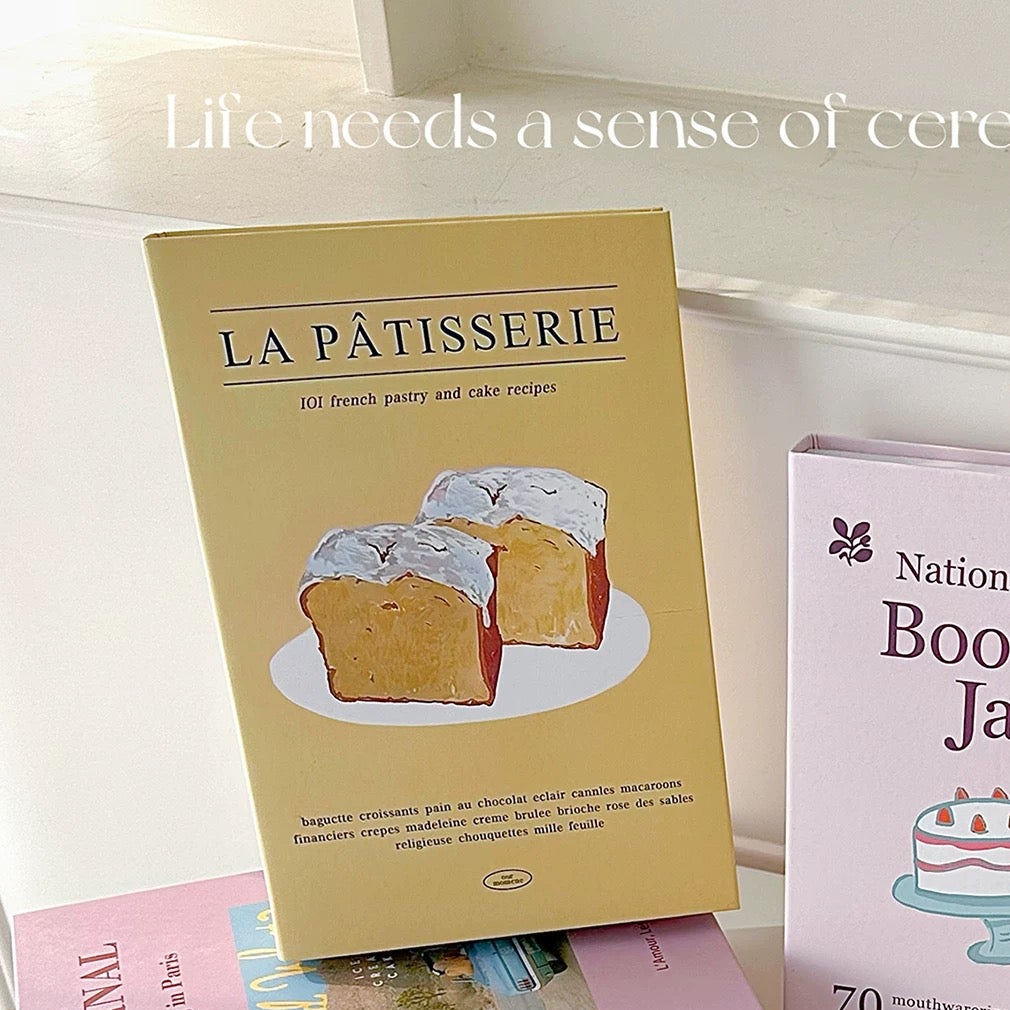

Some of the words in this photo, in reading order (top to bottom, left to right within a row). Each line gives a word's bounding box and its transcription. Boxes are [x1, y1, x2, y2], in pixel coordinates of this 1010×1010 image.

[218, 325, 295, 369] LA
[310, 305, 621, 363] PÂTISSERIE
[330, 393, 377, 408] french
[384, 391, 428, 407] pastry
[435, 387, 461, 401] and
[468, 384, 500, 399] cake
[507, 381, 557, 397] recipes
[293, 829, 355, 845] financiers
[361, 826, 400, 839] crepes
[405, 818, 468, 834] madeleine
[473, 813, 509, 825] creme
[515, 809, 551, 821] brulee
[557, 803, 601, 817] brioche
[606, 800, 631, 812] rose
[635, 797, 655, 809] des
[659, 793, 695, 807] sables
[299, 814, 354, 829] baguette
[359, 806, 419, 822] croissants
[425, 802, 452, 817] pain
[457, 801, 472, 811] au
[477, 794, 528, 809] chocolat
[532, 790, 566, 803] eclair
[620, 779, 682, 794] macaroons
[395, 835, 453, 851] religieuse
[458, 826, 529, 844] chouquettes
[534, 823, 564, 836] mille
[568, 819, 605, 832] feuille
[159, 952, 183, 991] Paris
[165, 992, 186, 1008] in
